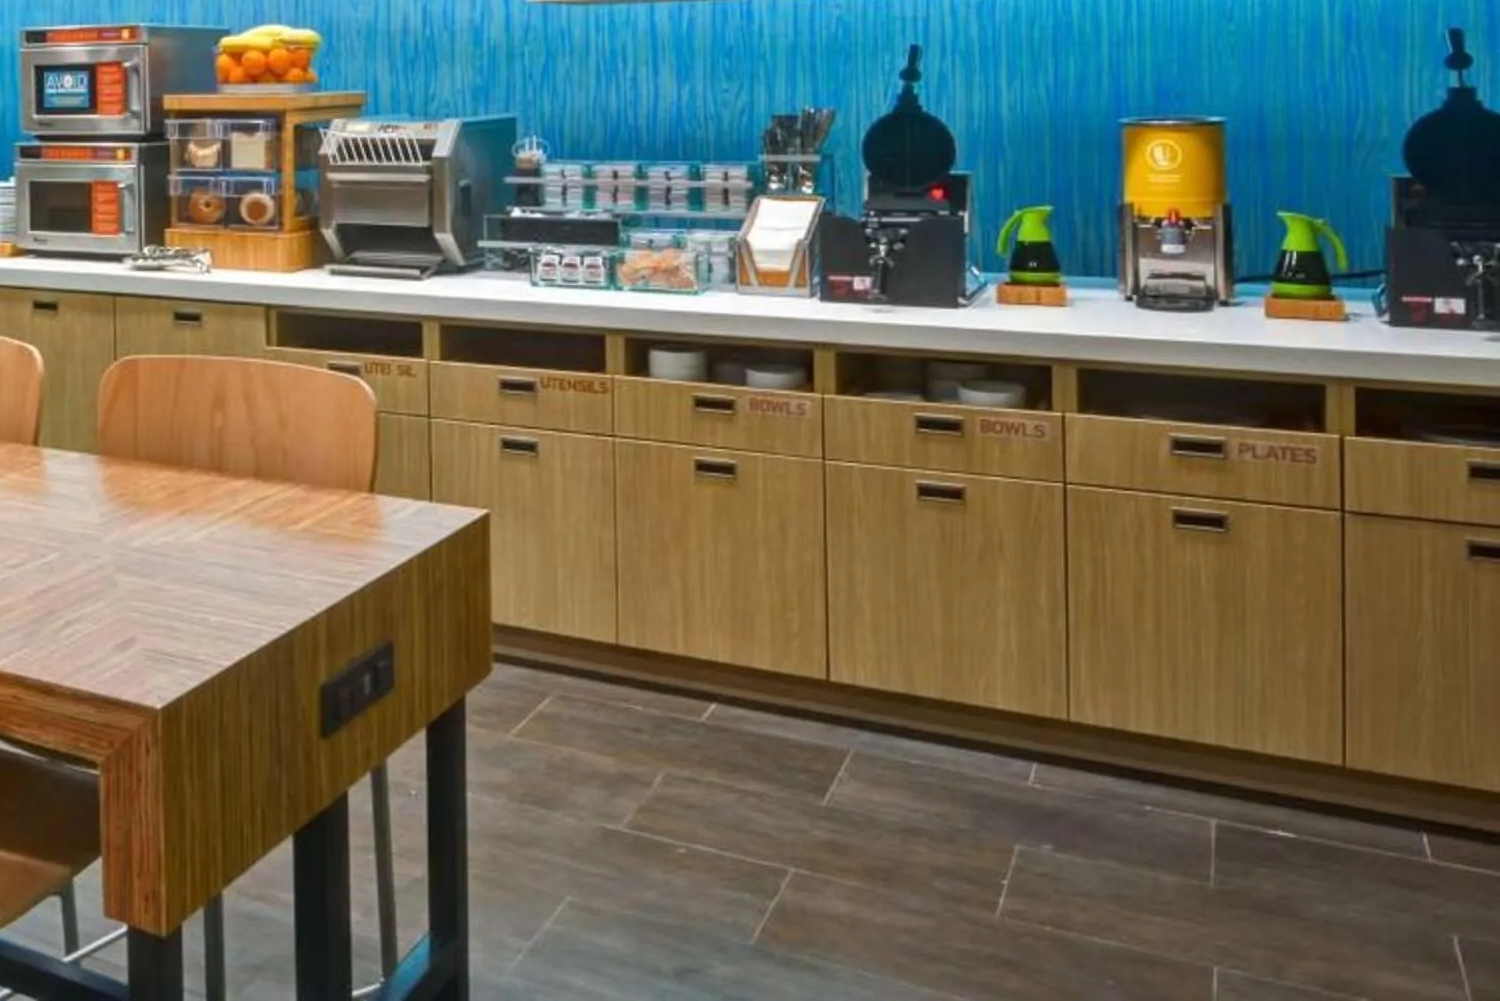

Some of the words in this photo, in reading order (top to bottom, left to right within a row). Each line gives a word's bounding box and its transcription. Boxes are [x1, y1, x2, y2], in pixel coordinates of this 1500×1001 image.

[540, 374, 609, 395] UTENSILS
[749, 396, 807, 417] BOWLS
[979, 418, 1046, 439] BOWLS
[1238, 442, 1317, 465] PLATES
